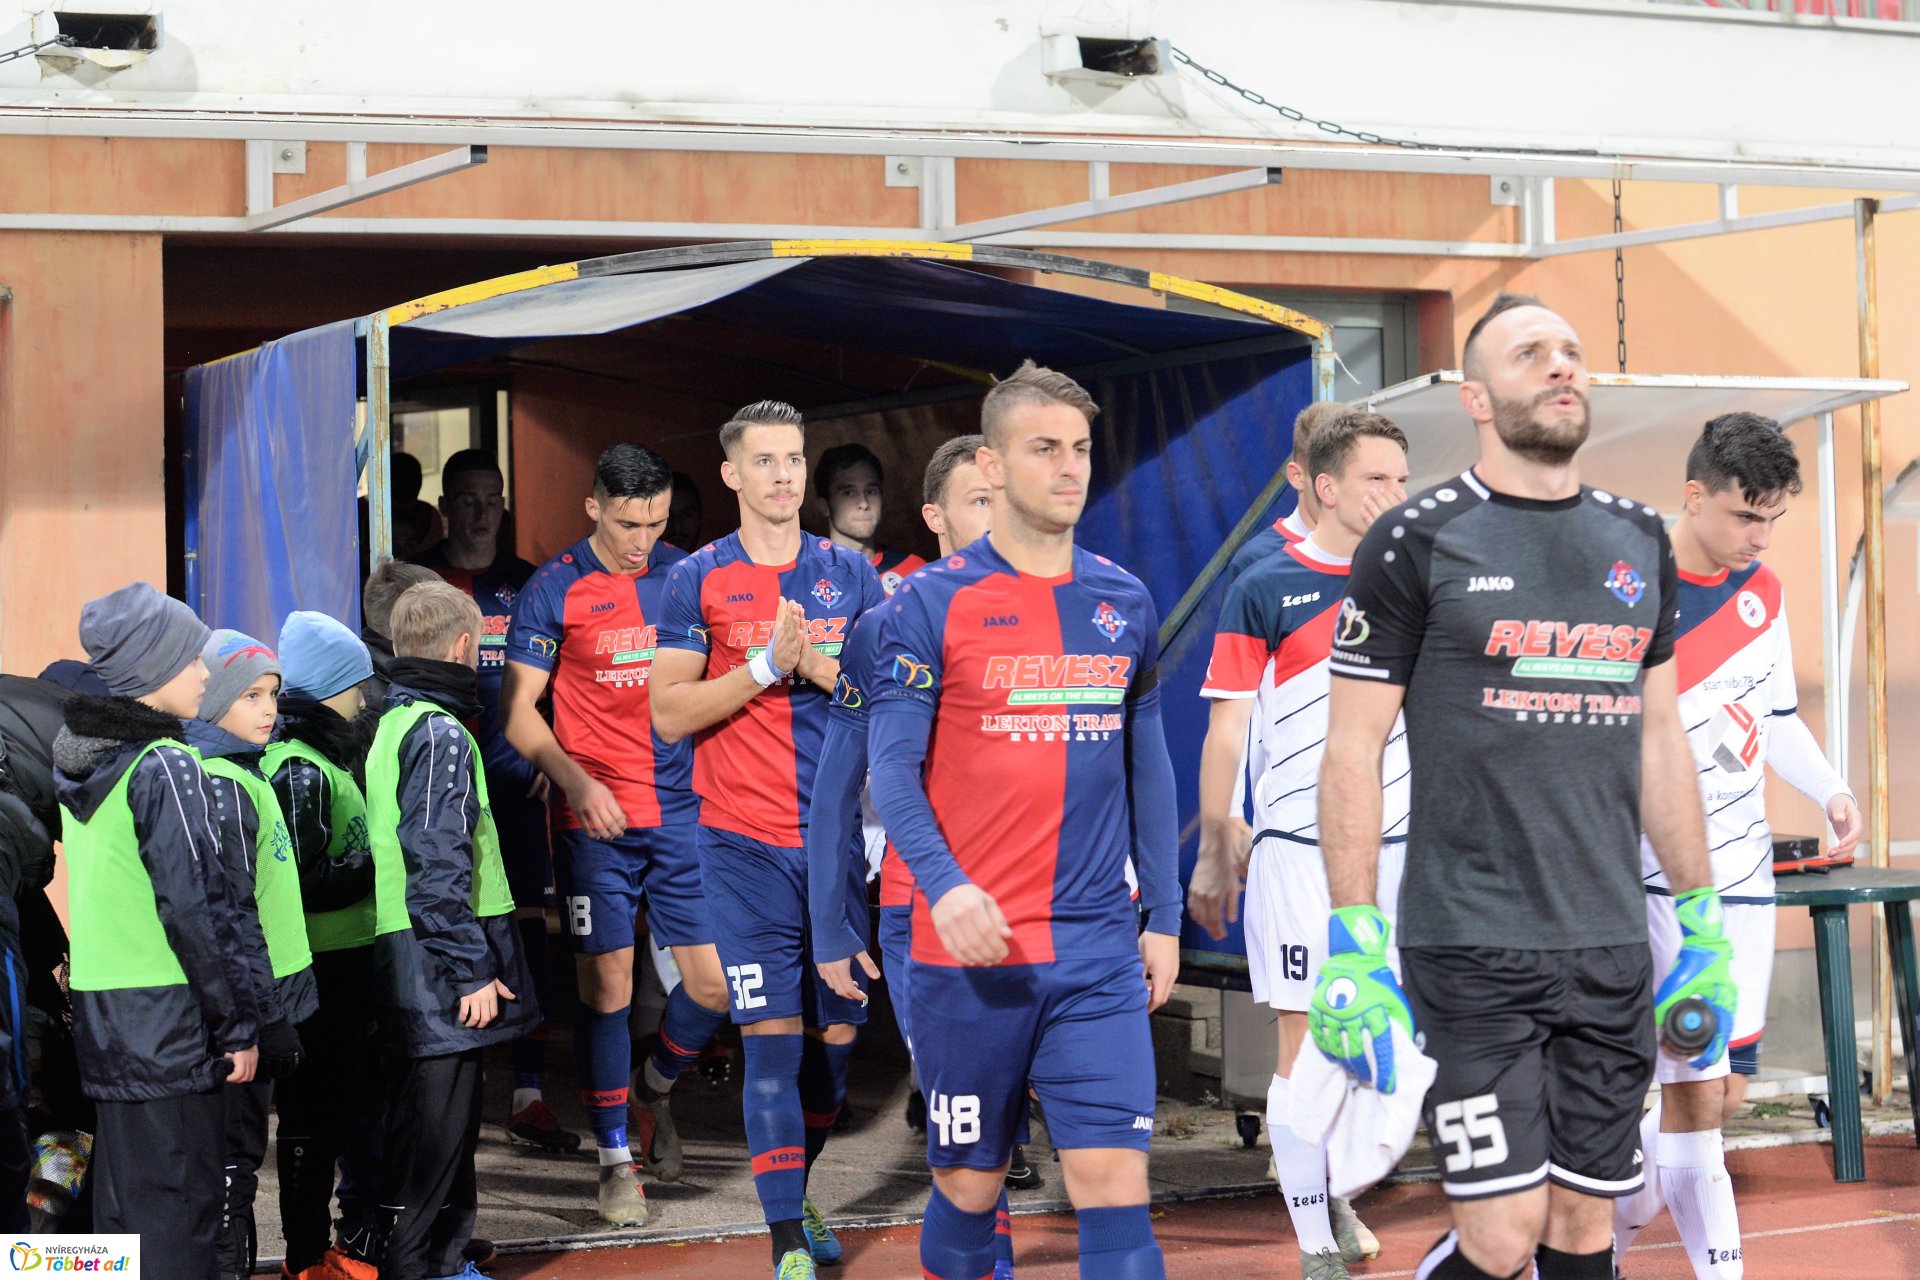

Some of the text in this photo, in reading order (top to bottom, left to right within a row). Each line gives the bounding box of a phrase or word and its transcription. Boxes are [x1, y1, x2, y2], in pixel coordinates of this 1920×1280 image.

[1466, 576, 1515, 592] JAKO
[591, 602, 615, 613] JAKO
[726, 593, 754, 603] JAKO
[1282, 591, 1321, 607] Zeus
[982, 615, 1019, 627] JAKO
[1484, 620, 1653, 662] REVESZ
[982, 655, 1131, 689] REVESZ
[1012, 692, 1049, 700] ALWAYS
[1051, 692, 1062, 700] ON
[1065, 692, 1081, 700] THE
[1482, 687, 1583, 712] LERTON
[981, 714, 1070, 731] LERTON
[1280, 943, 1308, 981] 19
[727, 963, 767, 1010] 32
[930, 1089, 981, 1146] 48
[1435, 1093, 1508, 1172] 55
